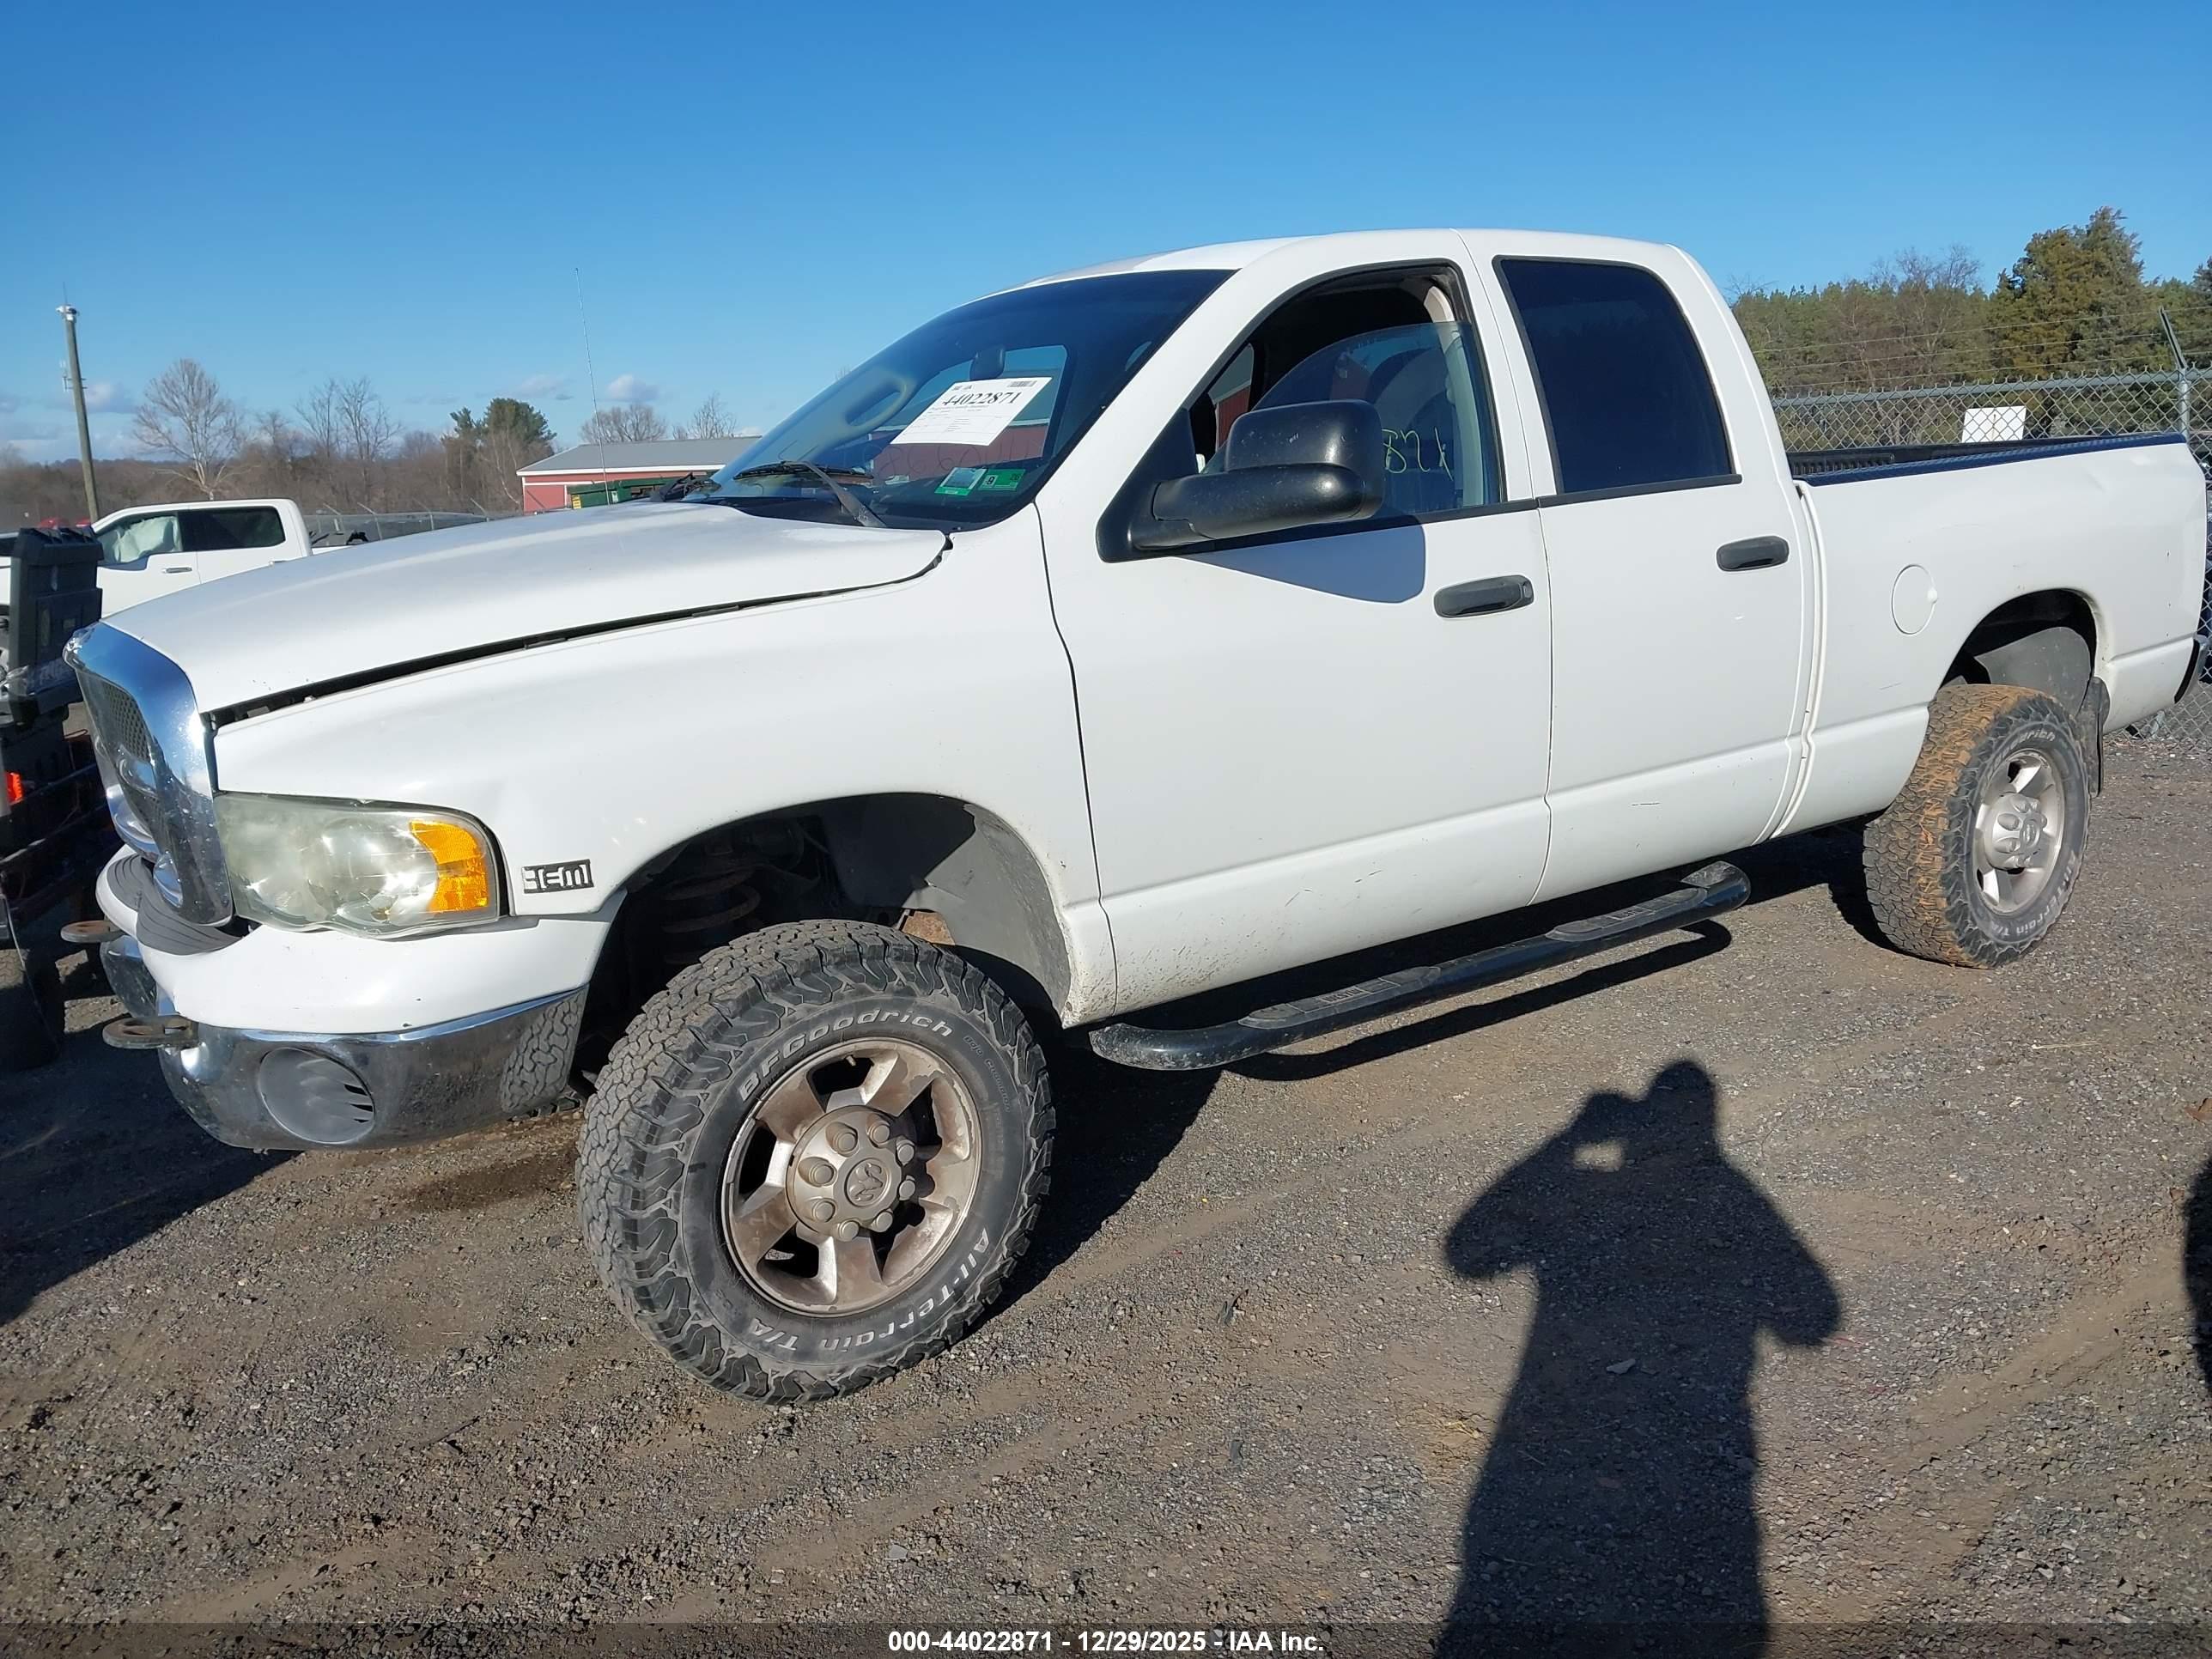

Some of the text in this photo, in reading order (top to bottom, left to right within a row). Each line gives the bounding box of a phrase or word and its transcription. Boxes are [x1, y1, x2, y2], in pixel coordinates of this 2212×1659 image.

[942, 392, 1023, 406] 44022871
[739, 1009, 952, 1102] BFGoodrich
[749, 1228, 990, 1353] All-Terrain T/A
